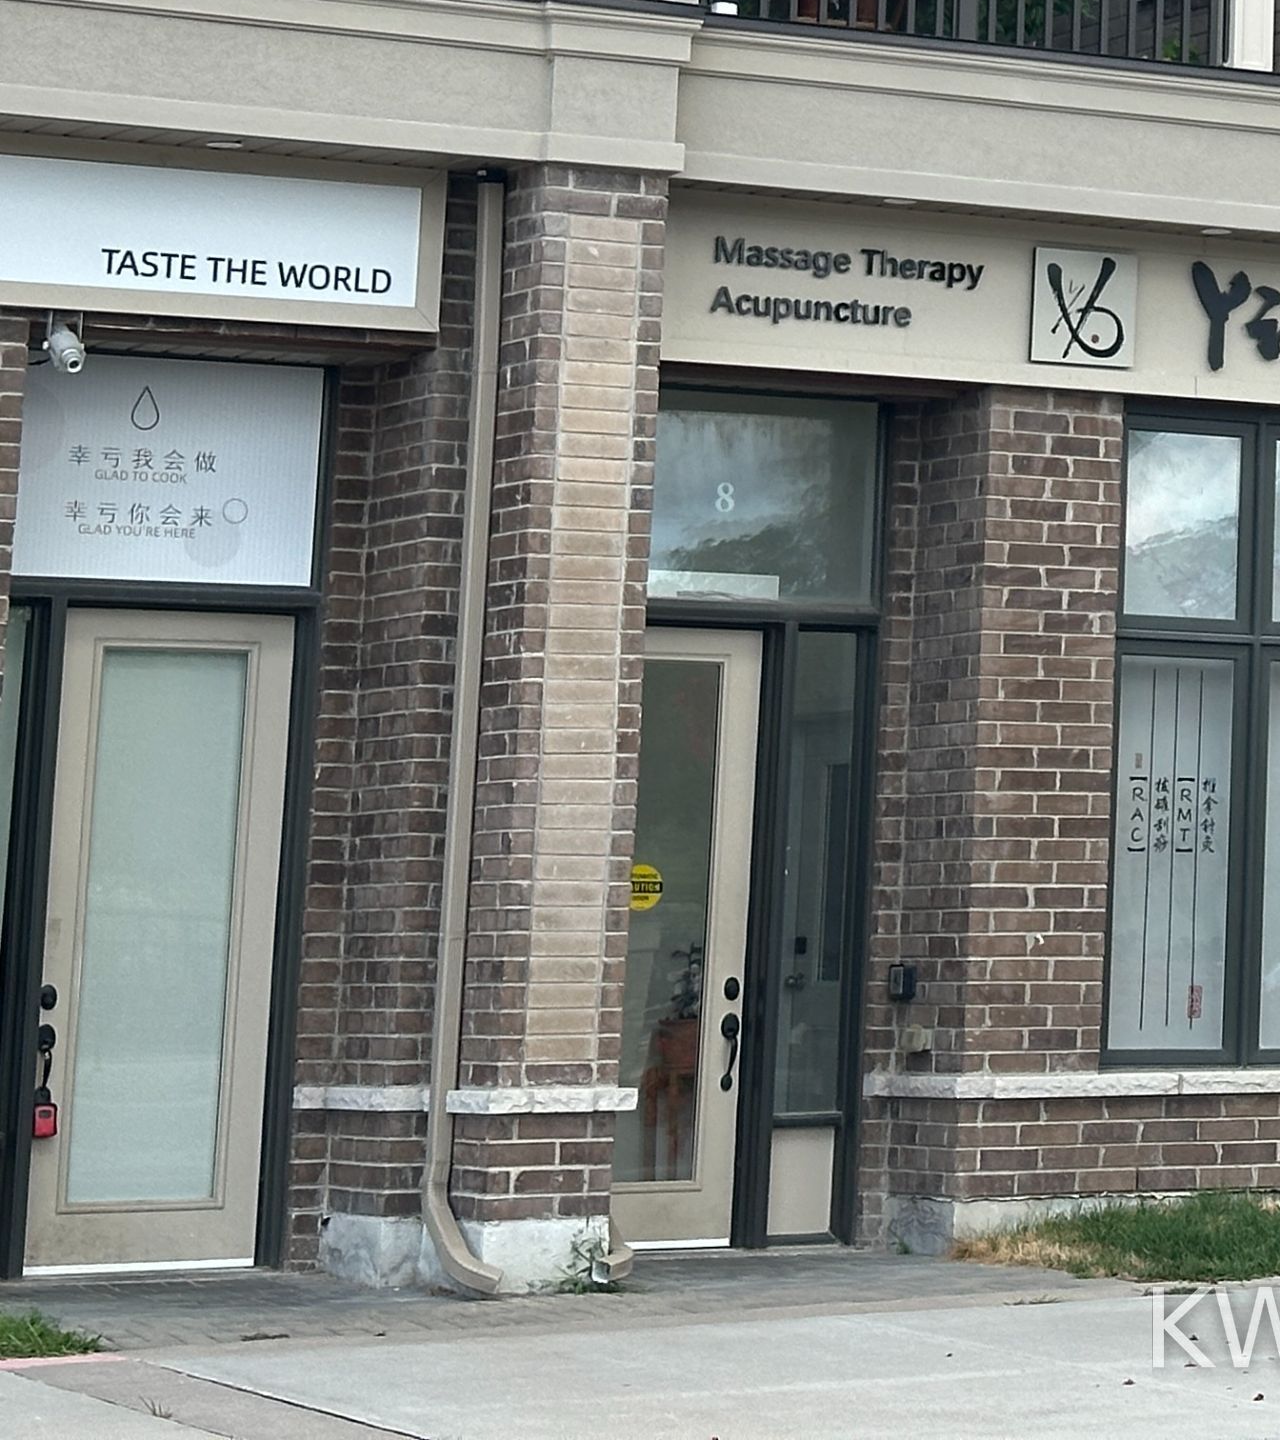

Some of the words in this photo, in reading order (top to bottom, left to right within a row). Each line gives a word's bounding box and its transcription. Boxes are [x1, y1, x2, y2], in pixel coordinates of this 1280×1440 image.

[101, 248, 197, 280] TASTE
[206, 256, 268, 286] THE
[278, 261, 392, 294] WORLD
[714, 235, 852, 280] Massage
[860, 248, 985, 291] Therapy
[710, 285, 912, 328] Acupuncture
[68, 444, 217, 473] 幸亏我会做
[95, 468, 128, 481] GLAD
[133, 471, 148, 482] TO
[152, 472, 187, 484] COOK
[714, 482, 735, 513] 8
[78, 524, 112, 535] GLAD
[164, 527, 196, 539] HERE
